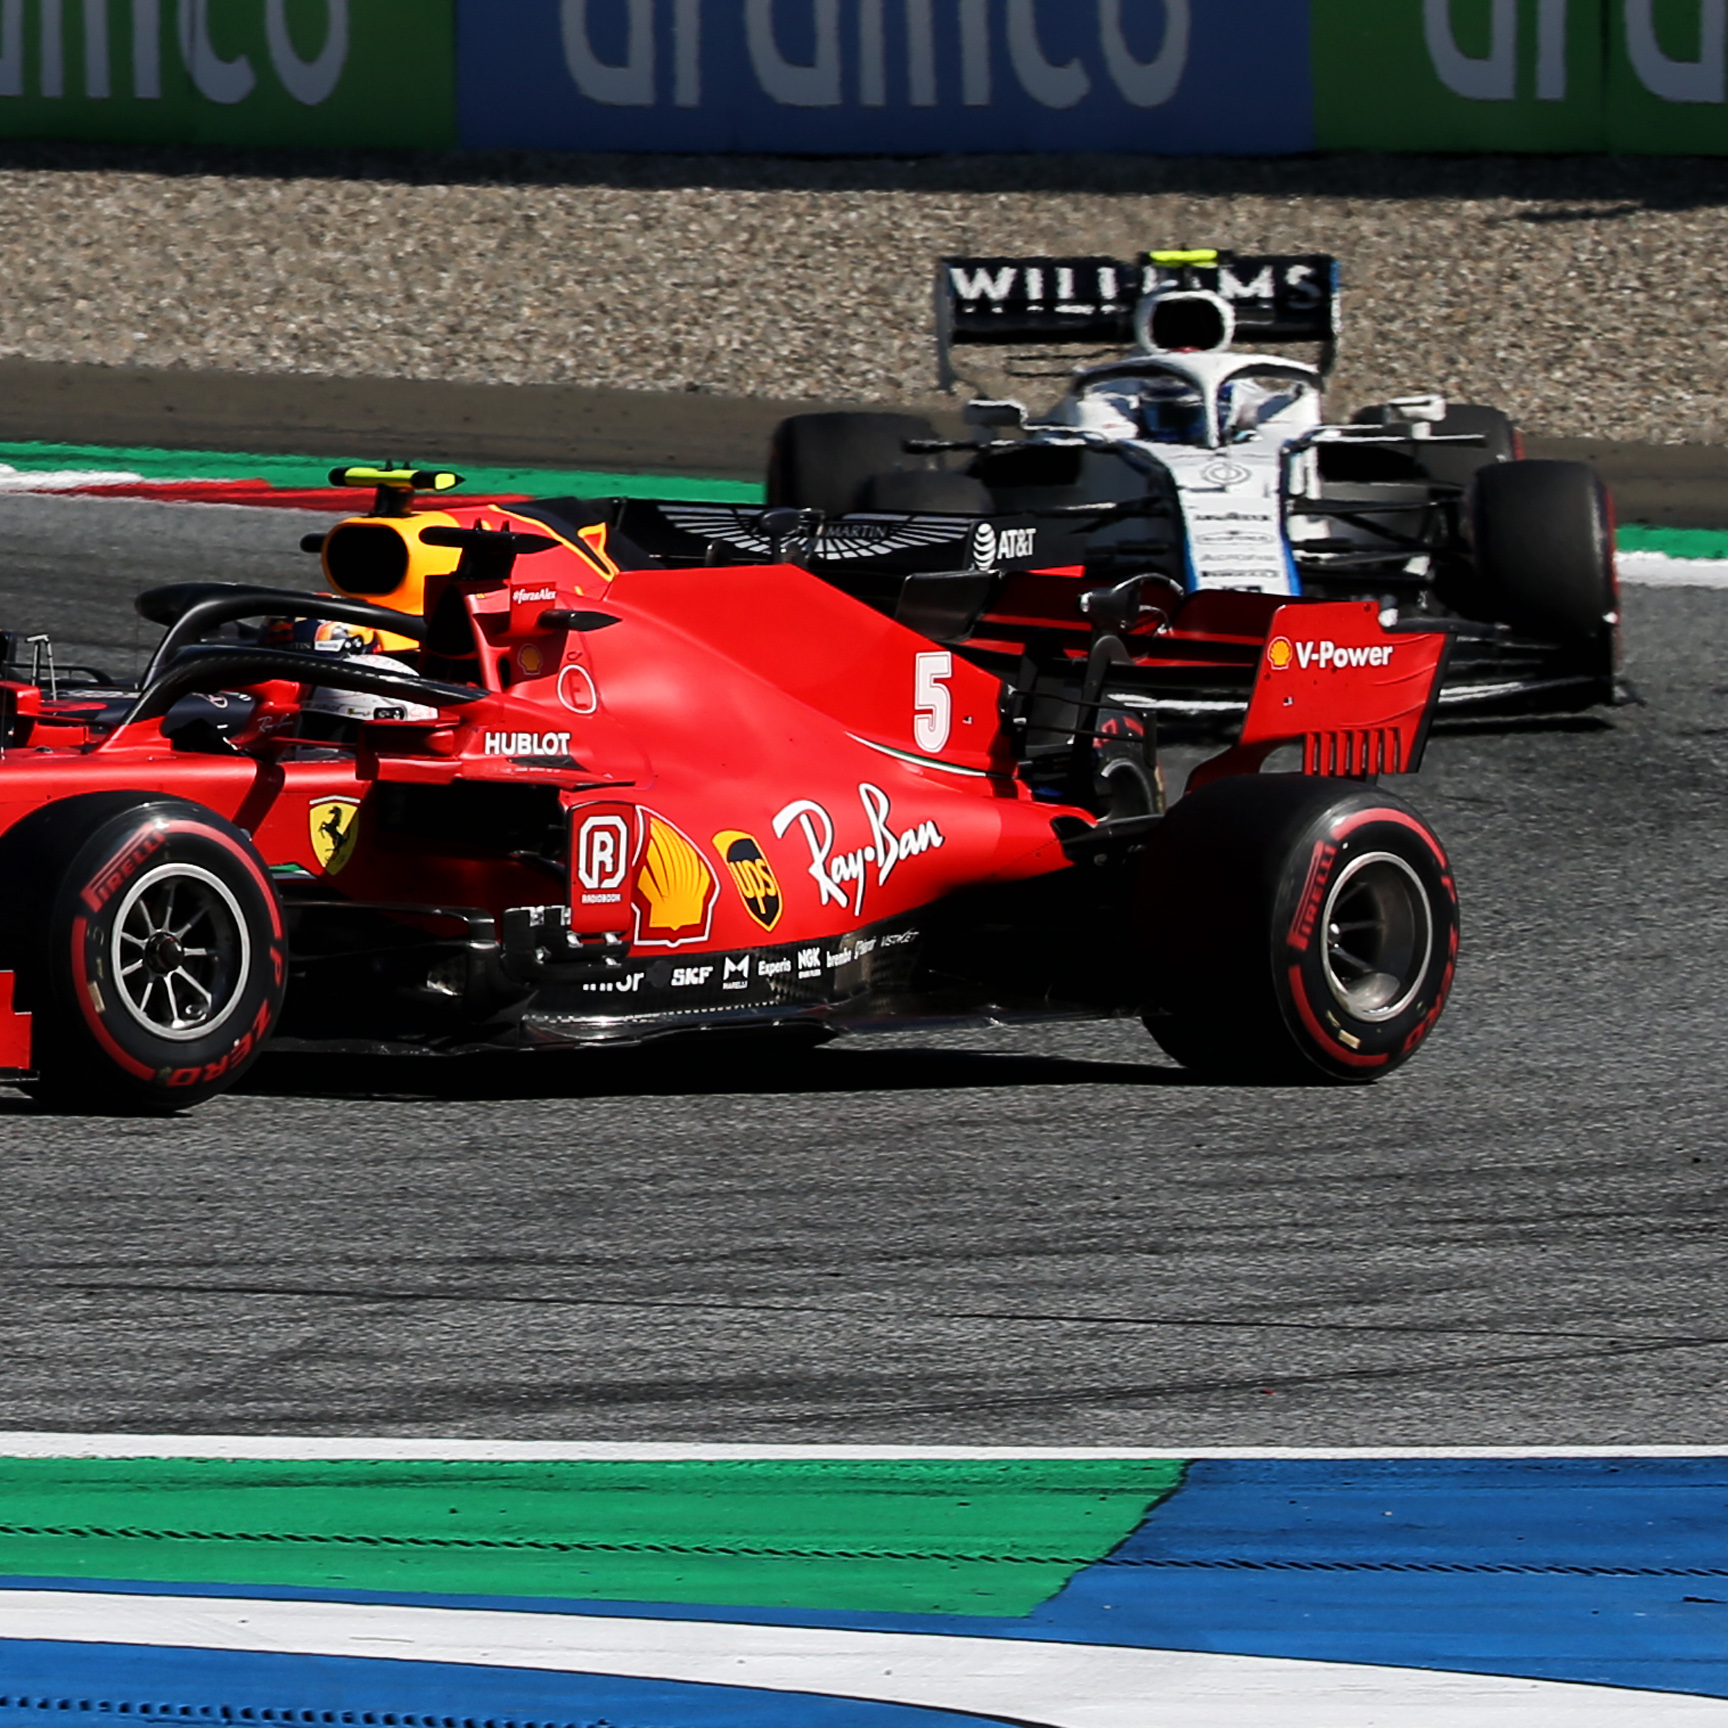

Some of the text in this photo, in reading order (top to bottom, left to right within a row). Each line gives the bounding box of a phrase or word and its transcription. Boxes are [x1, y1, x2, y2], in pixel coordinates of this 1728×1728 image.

[827, 523, 888, 538] MARTIN
[997, 529, 1036, 558] AT&T
[1296, 641, 1393, 668] V-Power
[914, 651, 952, 753] 5
[485, 732, 571, 755] HUBLOT
[80, 820, 167, 913] PIRELLI
[1286, 839, 1338, 951] PIRELLI
[758, 958, 792, 976] Experis
[798, 947, 821, 969] NGK
[671, 966, 713, 986] SKF
[166, 998, 271, 1087] ZERO
